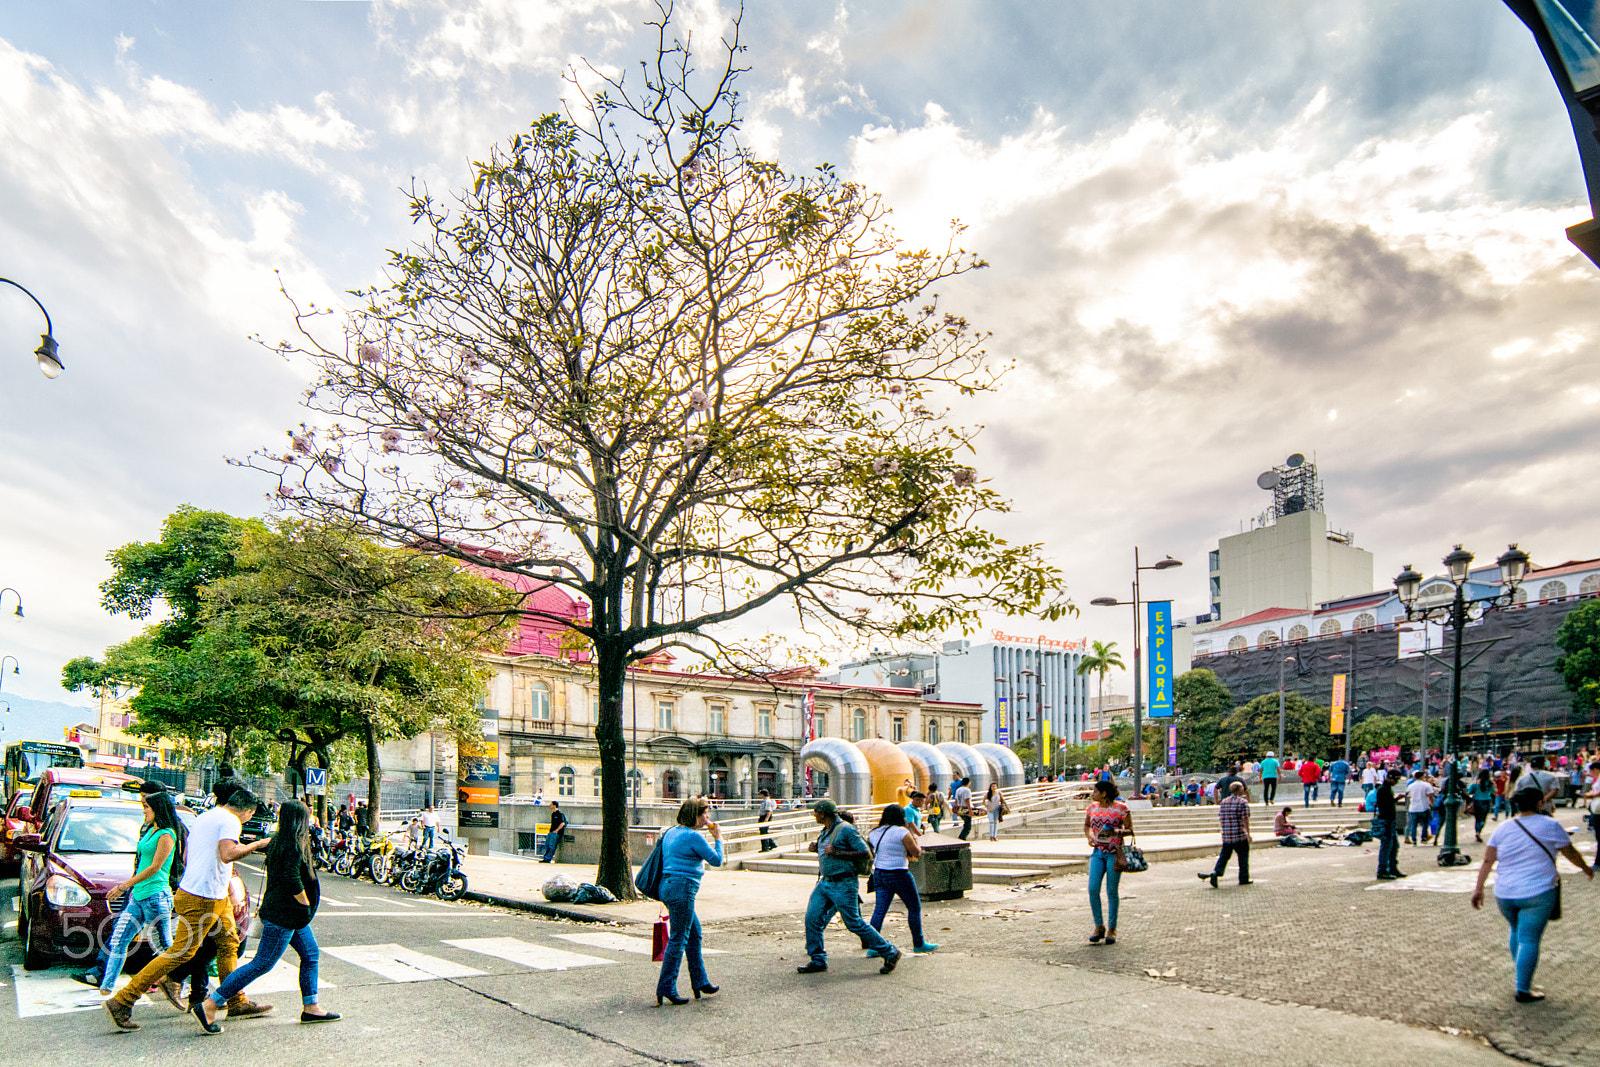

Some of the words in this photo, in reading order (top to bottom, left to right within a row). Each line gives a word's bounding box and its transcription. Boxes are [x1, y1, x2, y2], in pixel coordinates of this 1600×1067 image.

[991, 628, 1033, 644] Banco
[1037, 635, 1081, 651] Popular
[1155, 611, 1166, 701] EXPLORÁ
[1334, 679, 1342, 707] MUSEOS
[999, 701, 1007, 729] MUSEOS
